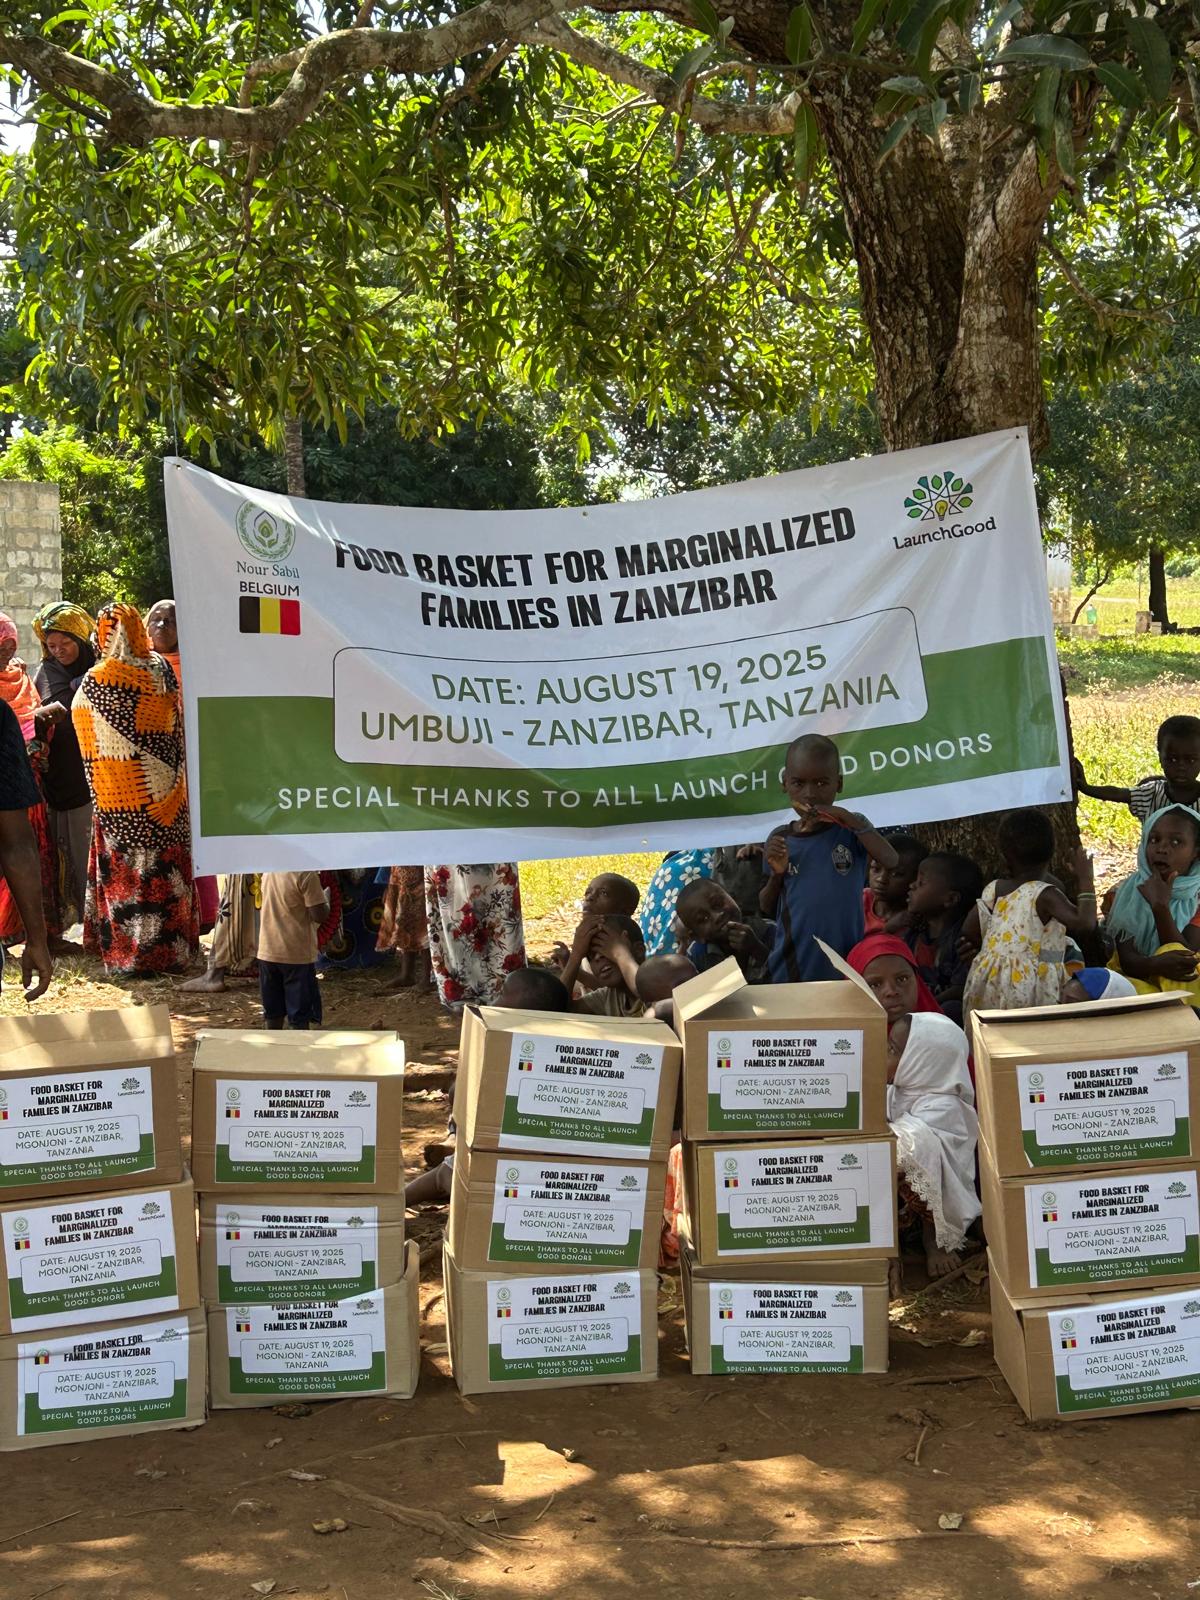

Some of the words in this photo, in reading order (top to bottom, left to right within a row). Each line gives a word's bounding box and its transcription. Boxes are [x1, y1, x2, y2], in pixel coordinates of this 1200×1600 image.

[893, 517, 996, 550] LaunchGood
[336, 540, 409, 577] FOOD
[413, 554, 533, 588] BASKET
[543, 550, 608, 584] FOR
[614, 506, 856, 579] MARGINALIZED
[236, 561, 269, 576] Nour
[272, 564, 300, 579] Sabil
[240, 581, 300, 597] BELGIUM
[421, 592, 560, 630] FAMILIES
[567, 592, 603, 627] IN
[610, 568, 777, 624] ZANZIBAR
[431, 674, 525, 705] DATE:
[536, 668, 677, 705] AUGUST
[687, 662, 729, 695] 19,
[737, 645, 827, 684] 2025
[361, 712, 493, 745] UMBUJI
[523, 709, 712, 746] ZANZIBAR,
[720, 673, 899, 730] TANZANIA
[278, 786, 399, 810] SPECIAL
[412, 786, 530, 809] THANKS
[541, 790, 580, 808] TO
[593, 785, 643, 807] ALL
[655, 772, 768, 804] LAUNCH
[870, 732, 993, 772] DONORS
[752, 1039, 770, 1047] FOOD
[773, 1039, 800, 1047] BASKET
[555, 1044, 574, 1054] FOOD
[576, 1046, 603, 1056] BASKET
[605, 1049, 620, 1058] FOR
[758, 1049, 811, 1057] MARGINALIZED
[560, 1054, 613, 1068] MARGINALIZED
[788, 1059, 825, 1067] ZANZIBAR
[545, 1064, 577, 1075] FAMILIES
[579, 1067, 588, 1076] IN
[588, 1067, 625, 1079] ZANZIBAR
[1067, 1069, 1087, 1079] FOOD
[1089, 1067, 1120, 1077] BASKET
[1123, 1066, 1139, 1075] FOR
[30, 1084, 51, 1095] FOOD
[53, 1081, 84, 1092] BASKET
[87, 1080, 103, 1089] FOR
[1074, 1077, 1133, 1089] MARGINALIZED
[38, 1091, 97, 1105] MARGINALIZED
[263, 1088, 282, 1097] FOOD
[284, 1089, 313, 1097] BASKET
[316, 1089, 331, 1097] FOR
[1059, 1090, 1095, 1101] FAMILIES
[1097, 1090, 1106, 1098] IN
[1108, 1086, 1149, 1097] ZANZIBAR
[23, 1106, 59, 1118] FAMILIES
[61, 1105, 71, 1114] IN
[72, 1100, 113, 1113] ZANZIBAR
[269, 1099, 325, 1108] MARGINALIZED
[254, 1110, 288, 1118] FAMILIES
[290, 1110, 299, 1118] IN
[300, 1110, 339, 1119] ZANZIBAR
[1081, 1109, 1118, 1119] AUGUST
[1133, 1106, 1156, 1114] 2025
[274, 1130, 309, 1138] AUGUST
[245, 1140, 293, 1148] MGONJONI
[274, 1150, 318, 1158] TANZANIA
[540, 1170, 559, 1179] FOOD
[561, 1171, 588, 1180] BASKET
[590, 1173, 605, 1181] FOR
[545, 1180, 598, 1191] MARGINALIZED
[1079, 1188, 1099, 1198] FOOD
[1101, 1185, 1131, 1196] BASKET
[1134, 1184, 1150, 1193] FOR
[530, 1190, 563, 1200] FAMILIES
[565, 1192, 573, 1200] IN
[574, 1192, 610, 1202] ZANZIBAR
[771, 1195, 805, 1204] AUGUST
[818, 1193, 839, 1201] 2025
[1086, 1195, 1144, 1207] MARGINALIZED
[51, 1212, 72, 1223] FOOD
[74, 1208, 105, 1220] BASKET
[107, 1205, 123, 1215] FOR
[745, 1206, 791, 1214] MGONJONI
[1072, 1209, 1107, 1219] FAMILIES
[1109, 1208, 1118, 1216] IN
[1119, 1203, 1159, 1215] ZANZIBAR
[773, 1214, 815, 1222] TANZANIA
[59, 1217, 118, 1233] MARGINALIZED
[44, 1233, 81, 1246] FAMILIES
[83, 1232, 92, 1241] IN
[93, 1225, 134, 1239] ZANZIBAR
[254, 1231, 287, 1239] FAMILIES
[299, 1229, 337, 1238] ZANZIBAR
[546, 1230, 588, 1239] TANZANIA
[532, 1286, 550, 1295] FOOD
[553, 1284, 580, 1293] BASKET
[583, 1283, 597, 1292] FOR
[753, 1289, 772, 1298] FOOD
[774, 1289, 801, 1298] BASKET
[804, 1290, 818, 1298] FOR
[538, 1294, 591, 1304] MARGINALIZED
[759, 1299, 813, 1308] MARGINALIZED
[278, 1310, 333, 1320] MARGINALIZED
[524, 1306, 557, 1316] FAMILIES
[559, 1306, 567, 1314] IN
[569, 1303, 605, 1313] ZANZIBAR
[746, 1310, 778, 1318] FAMILIES
[780, 1310, 788, 1318] IN
[790, 1310, 827, 1319] ZANZIBAR
[1096, 1312, 1116, 1323] FOOD
[1118, 1307, 1148, 1319] BASKET
[1150, 1305, 1166, 1315] FOR
[264, 1322, 297, 1331] FAMILIES
[299, 1322, 308, 1330] IN
[309, 1320, 348, 1329] ZANZIBAR
[1104, 1316, 1161, 1332] MARGINALIZED
[1090, 1332, 1125, 1345] FAMILIES
[1127, 1331, 1136, 1340] IN
[1137, 1324, 1177, 1338] ZANZIBAR
[545, 1343, 586, 1352] TANZANIA
[64, 1351, 99, 1362] FAMILIES
[102, 1350, 110, 1359] IN
[112, 1346, 151, 1358] ZANZIBAR
[85, 1370, 120, 1380] AUGUST
[135, 1367, 156, 1376] 2025
[1115, 1368, 1161, 1380] TANZANIA
